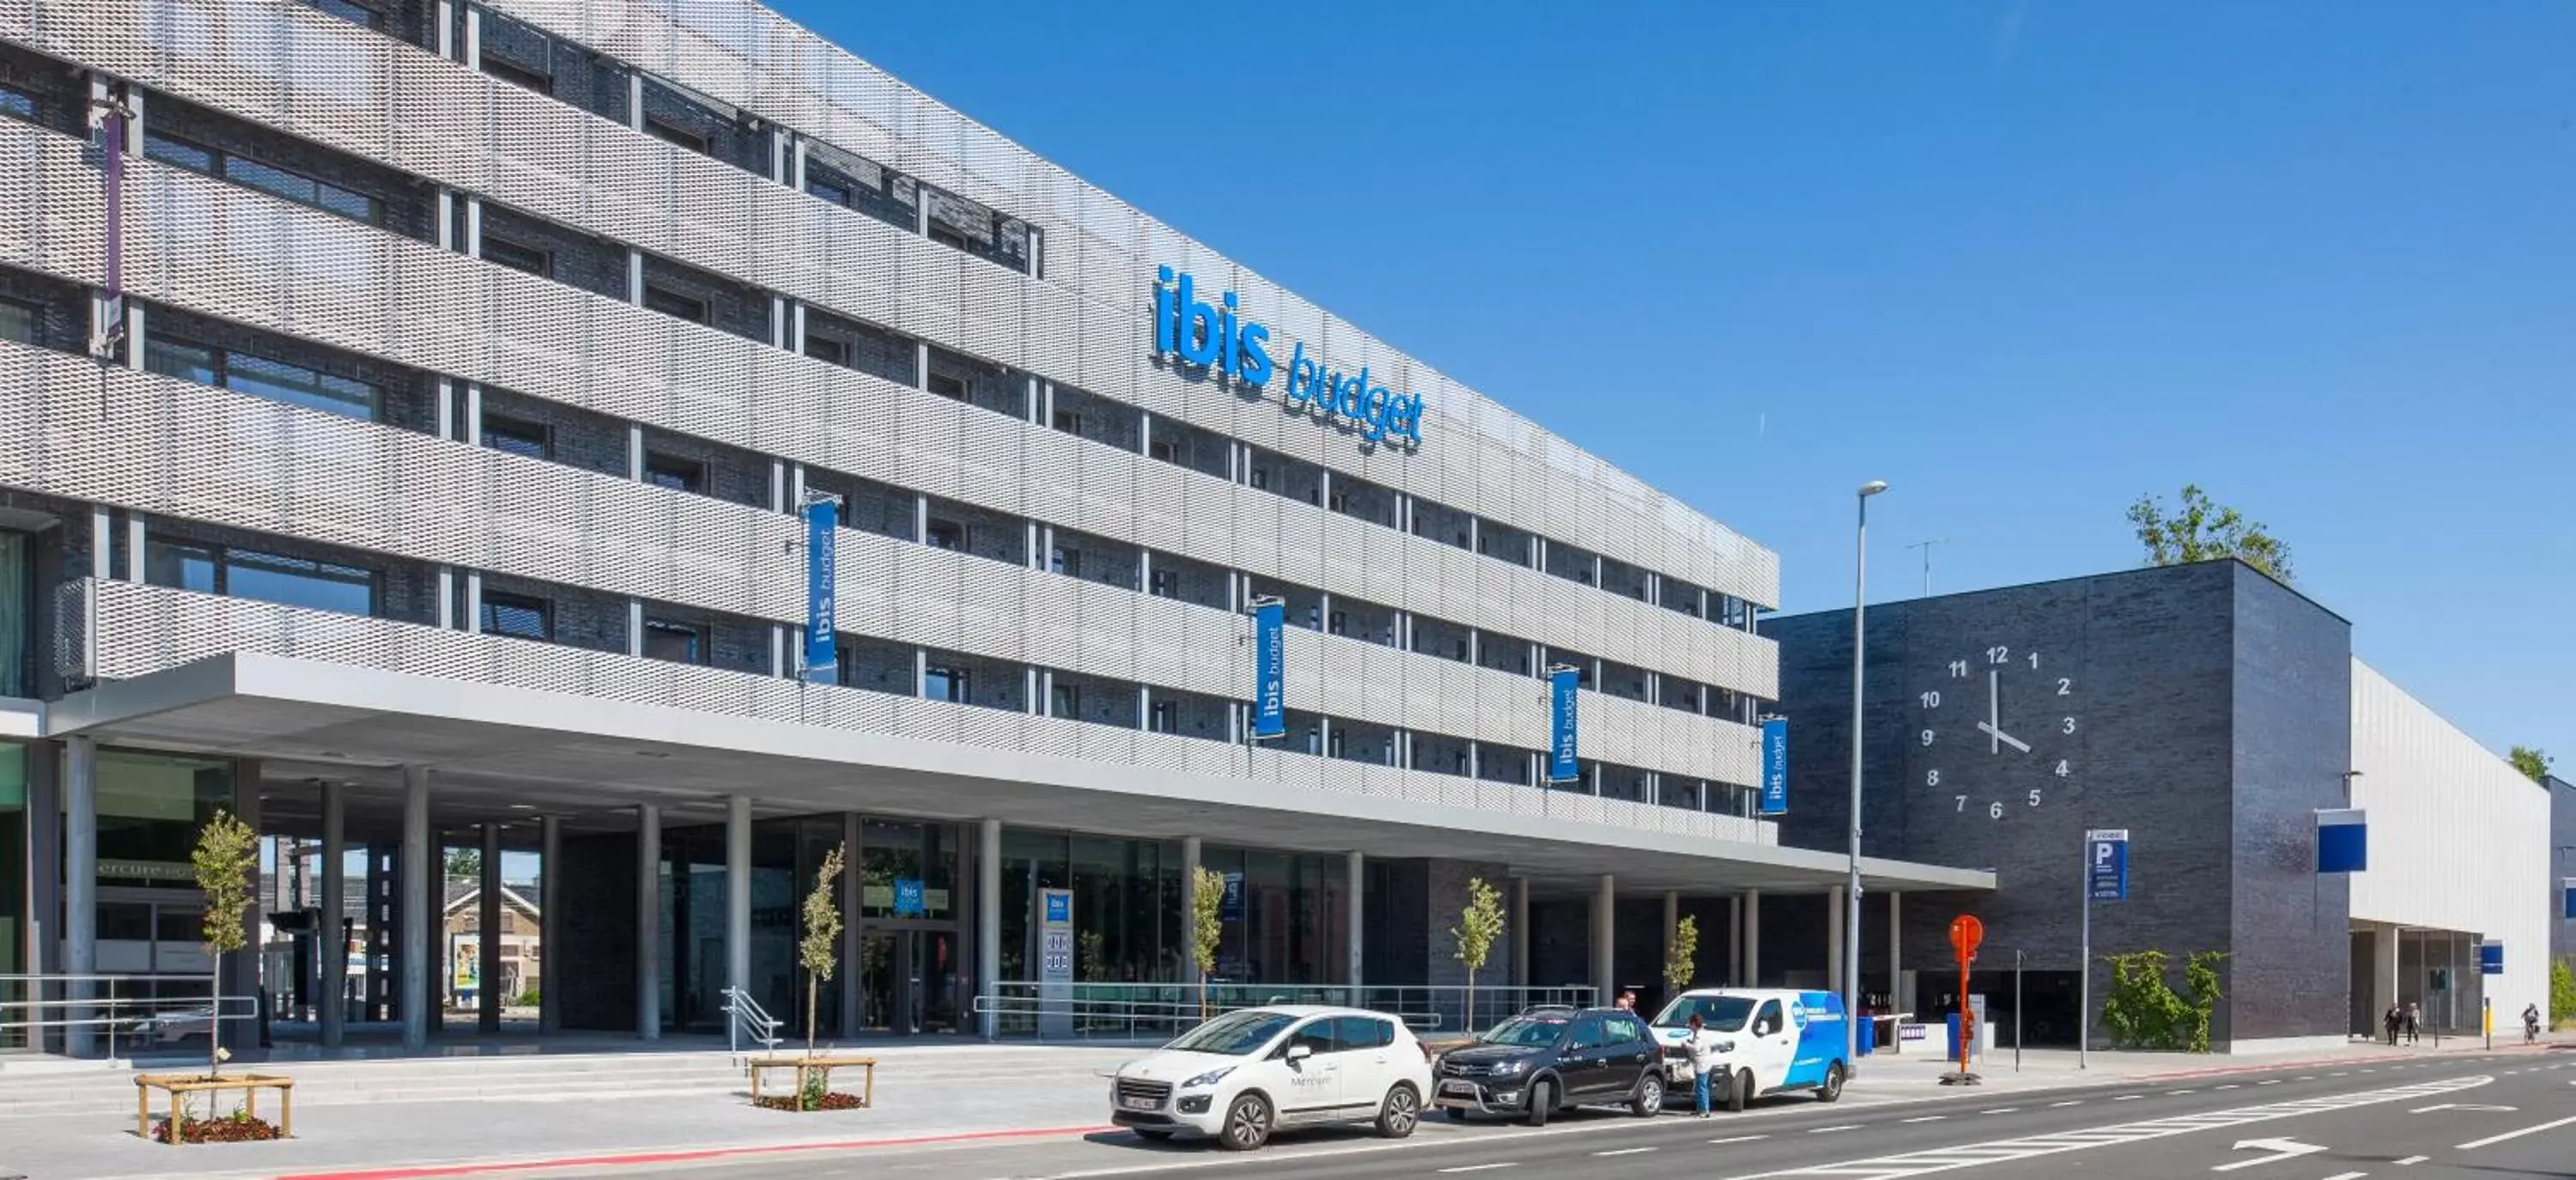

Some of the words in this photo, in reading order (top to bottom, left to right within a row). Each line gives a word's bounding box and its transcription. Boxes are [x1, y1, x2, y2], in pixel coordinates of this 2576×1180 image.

[1157, 265, 1273, 386] ibis
[1287, 341, 1425, 442] budget
[820, 528, 834, 590] budget
[815, 597, 831, 643] ibis
[1269, 627, 1281, 674] budget
[1986, 646, 2008, 664] 12
[1948, 660, 1967, 678] 11
[2028, 652, 2038, 670] 1
[2057, 678, 2070, 696] 2
[1264, 681, 1279, 717] ibis
[1920, 690, 1940, 709] 10
[2063, 716, 2075, 735] 3
[1922, 729, 1934, 745] 9
[1558, 733, 1574, 765] ibis
[2056, 759, 2070, 777] 4
[1769, 773, 1783, 800] ibis
[1927, 769, 1939, 786] 8
[1956, 795, 1967, 812] 7
[2029, 789, 2041, 807] 5
[1990, 801, 2002, 818] 6
[2096, 842, 2113, 865] P
[98, 863, 161, 876] ercure
